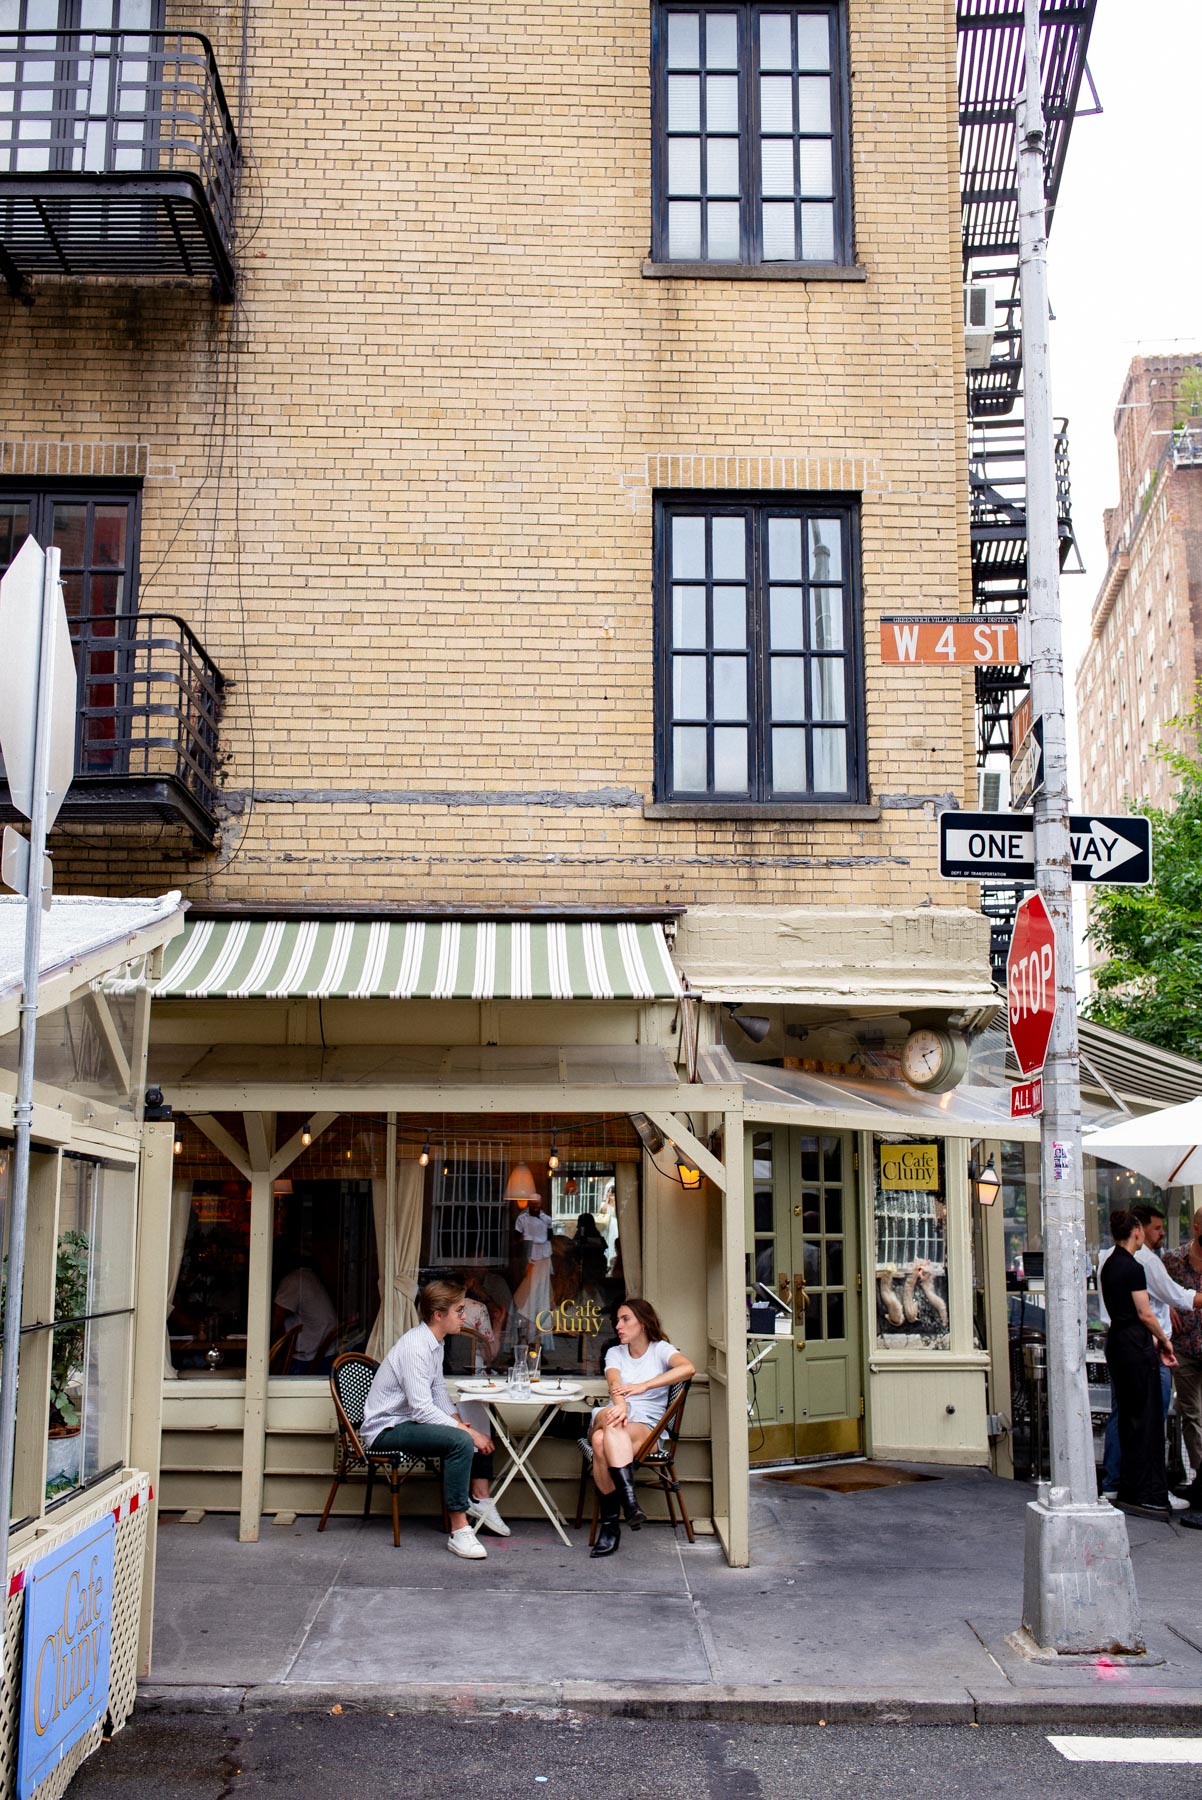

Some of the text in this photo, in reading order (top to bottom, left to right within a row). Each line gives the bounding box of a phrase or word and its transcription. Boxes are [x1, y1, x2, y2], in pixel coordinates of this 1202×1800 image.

[893, 624, 1009, 662] W 4 ST
[968, 833, 1024, 859] ONE
[1010, 943, 1053, 1025] STOP
[1014, 1089, 1032, 1110] ALL
[882, 1160, 936, 1185] Cluny
[901, 1151, 934, 1168] Cafe
[560, 1299, 602, 1317] Cafe
[535, 1309, 604, 1337] Cluny
[64, 1555, 104, 1645] Cafe
[34, 1621, 105, 1737] Cluny
